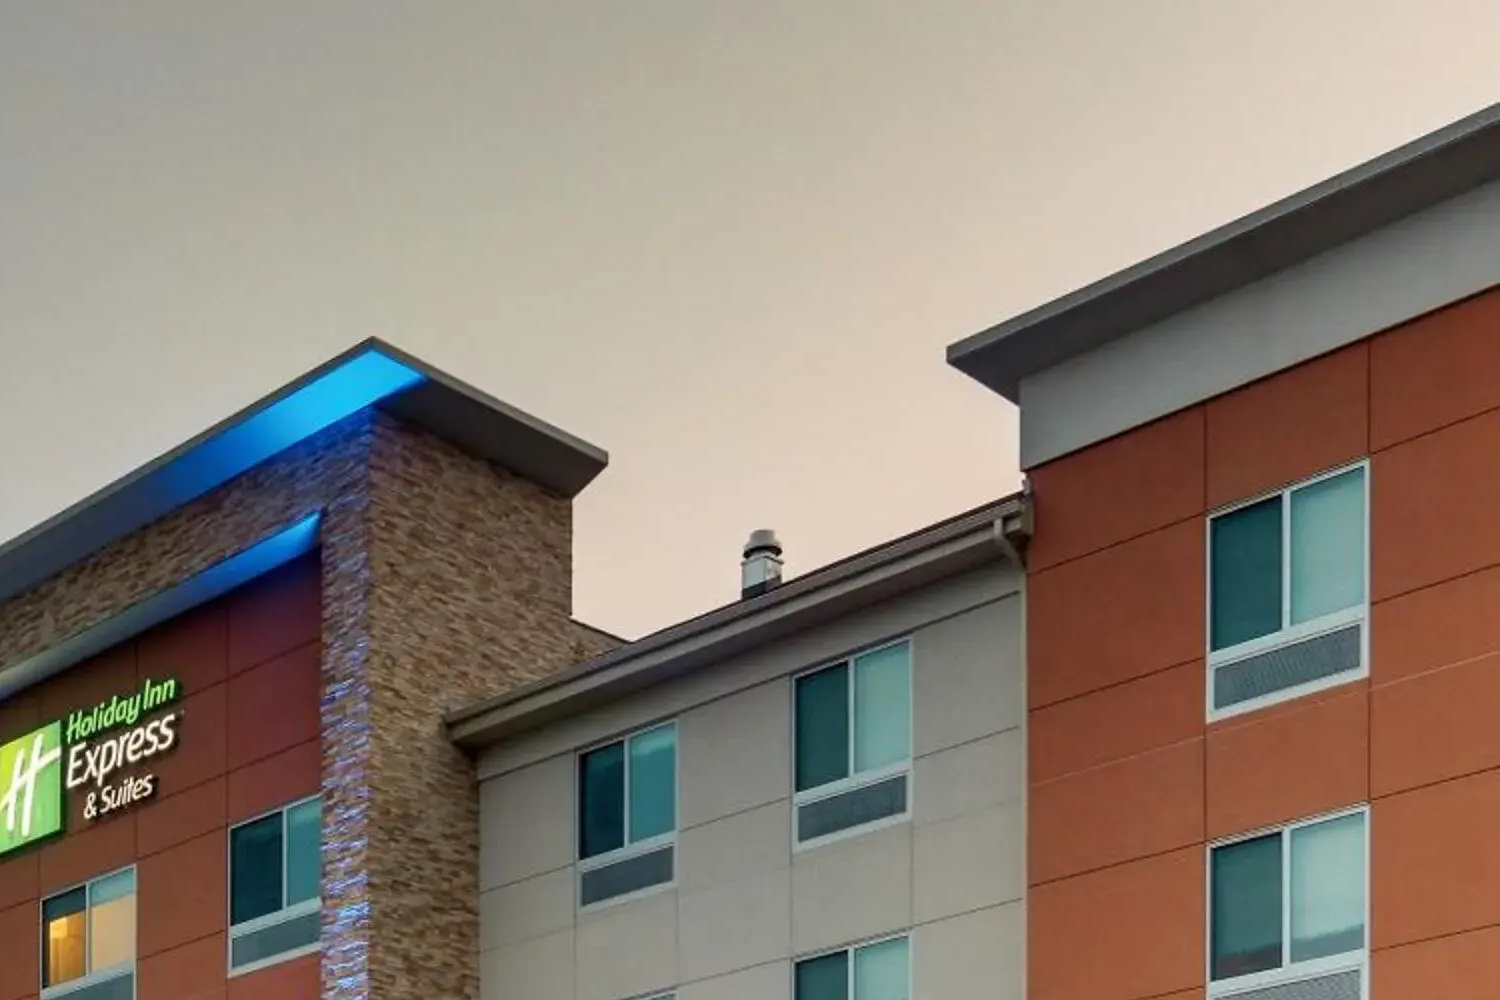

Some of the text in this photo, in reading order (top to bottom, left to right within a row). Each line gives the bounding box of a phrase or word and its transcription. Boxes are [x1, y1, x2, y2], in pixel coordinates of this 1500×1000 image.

[66, 679, 175, 743] Holiday Inn
[66, 713, 175, 789] Express
[84, 774, 153, 819] & Suites
